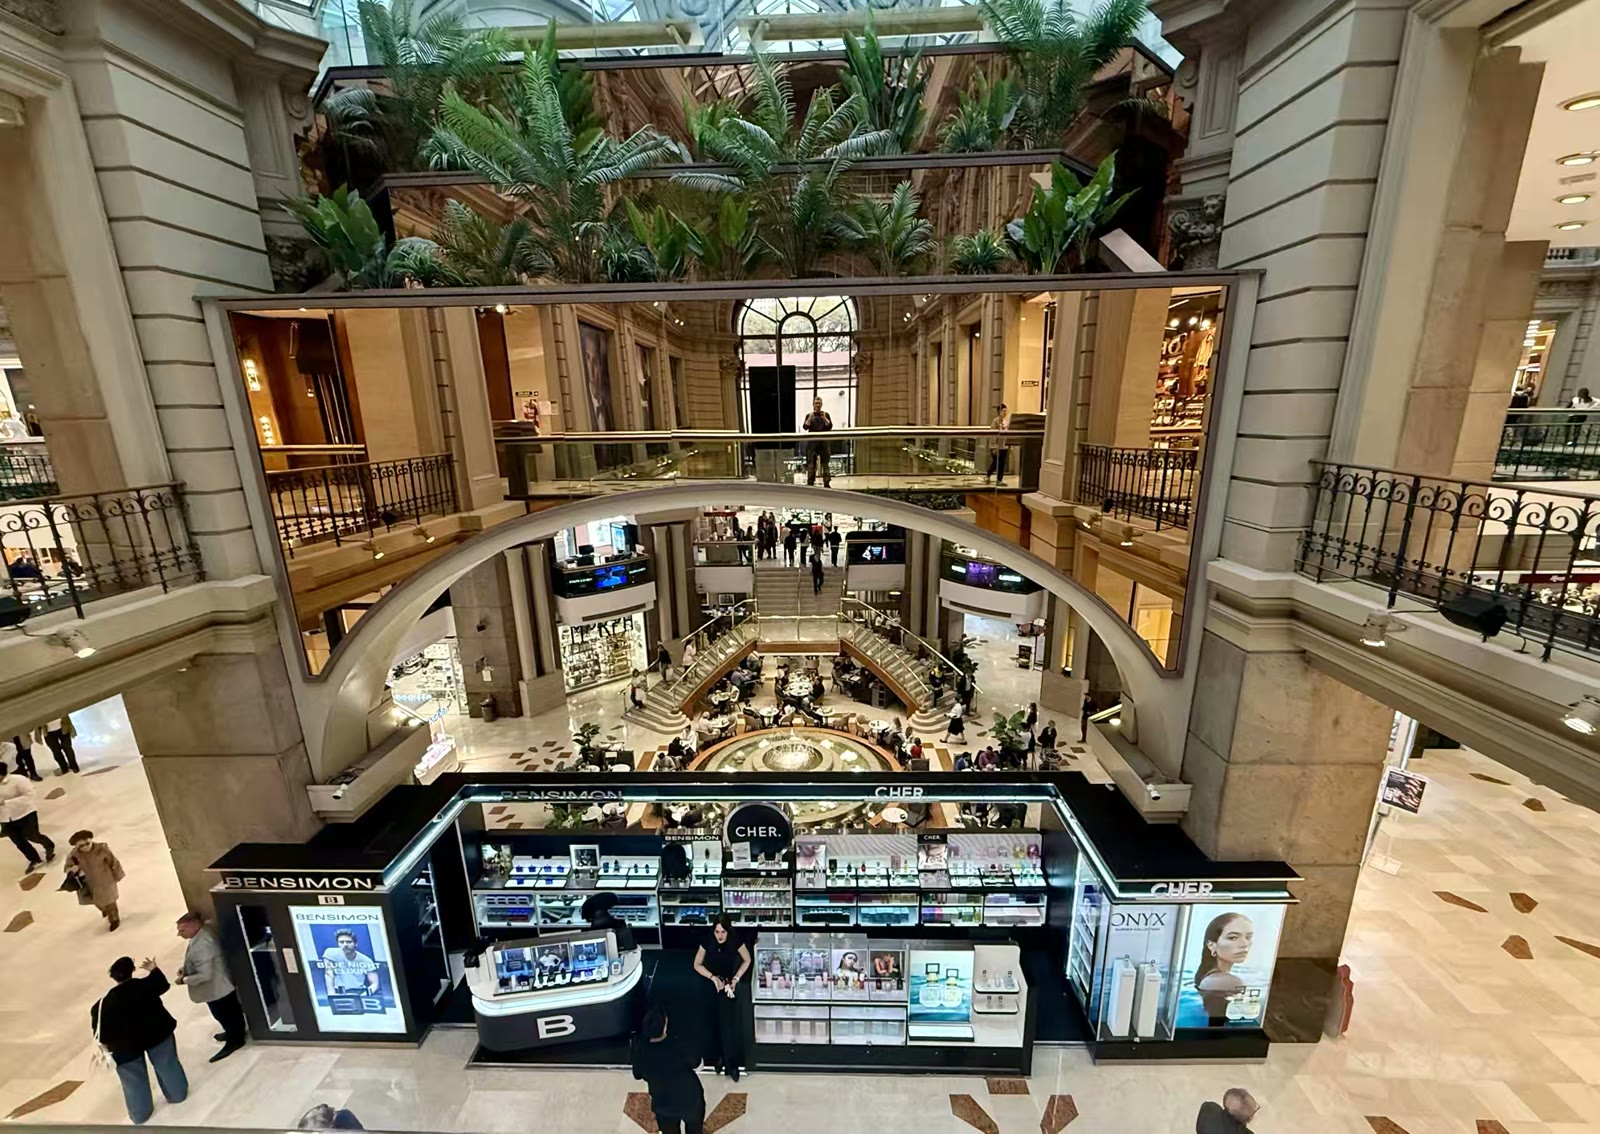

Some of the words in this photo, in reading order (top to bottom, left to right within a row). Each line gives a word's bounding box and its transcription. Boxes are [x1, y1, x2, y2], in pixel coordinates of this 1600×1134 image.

[500, 790, 622, 800] BENSIMON
[735, 826, 781, 837] CHER.
[225, 877, 372, 889] BENSIMON
[296, 913, 379, 921] BENSIMON
[1112, 912, 1167, 926] ONYX
[537, 1015, 576, 1039] B
